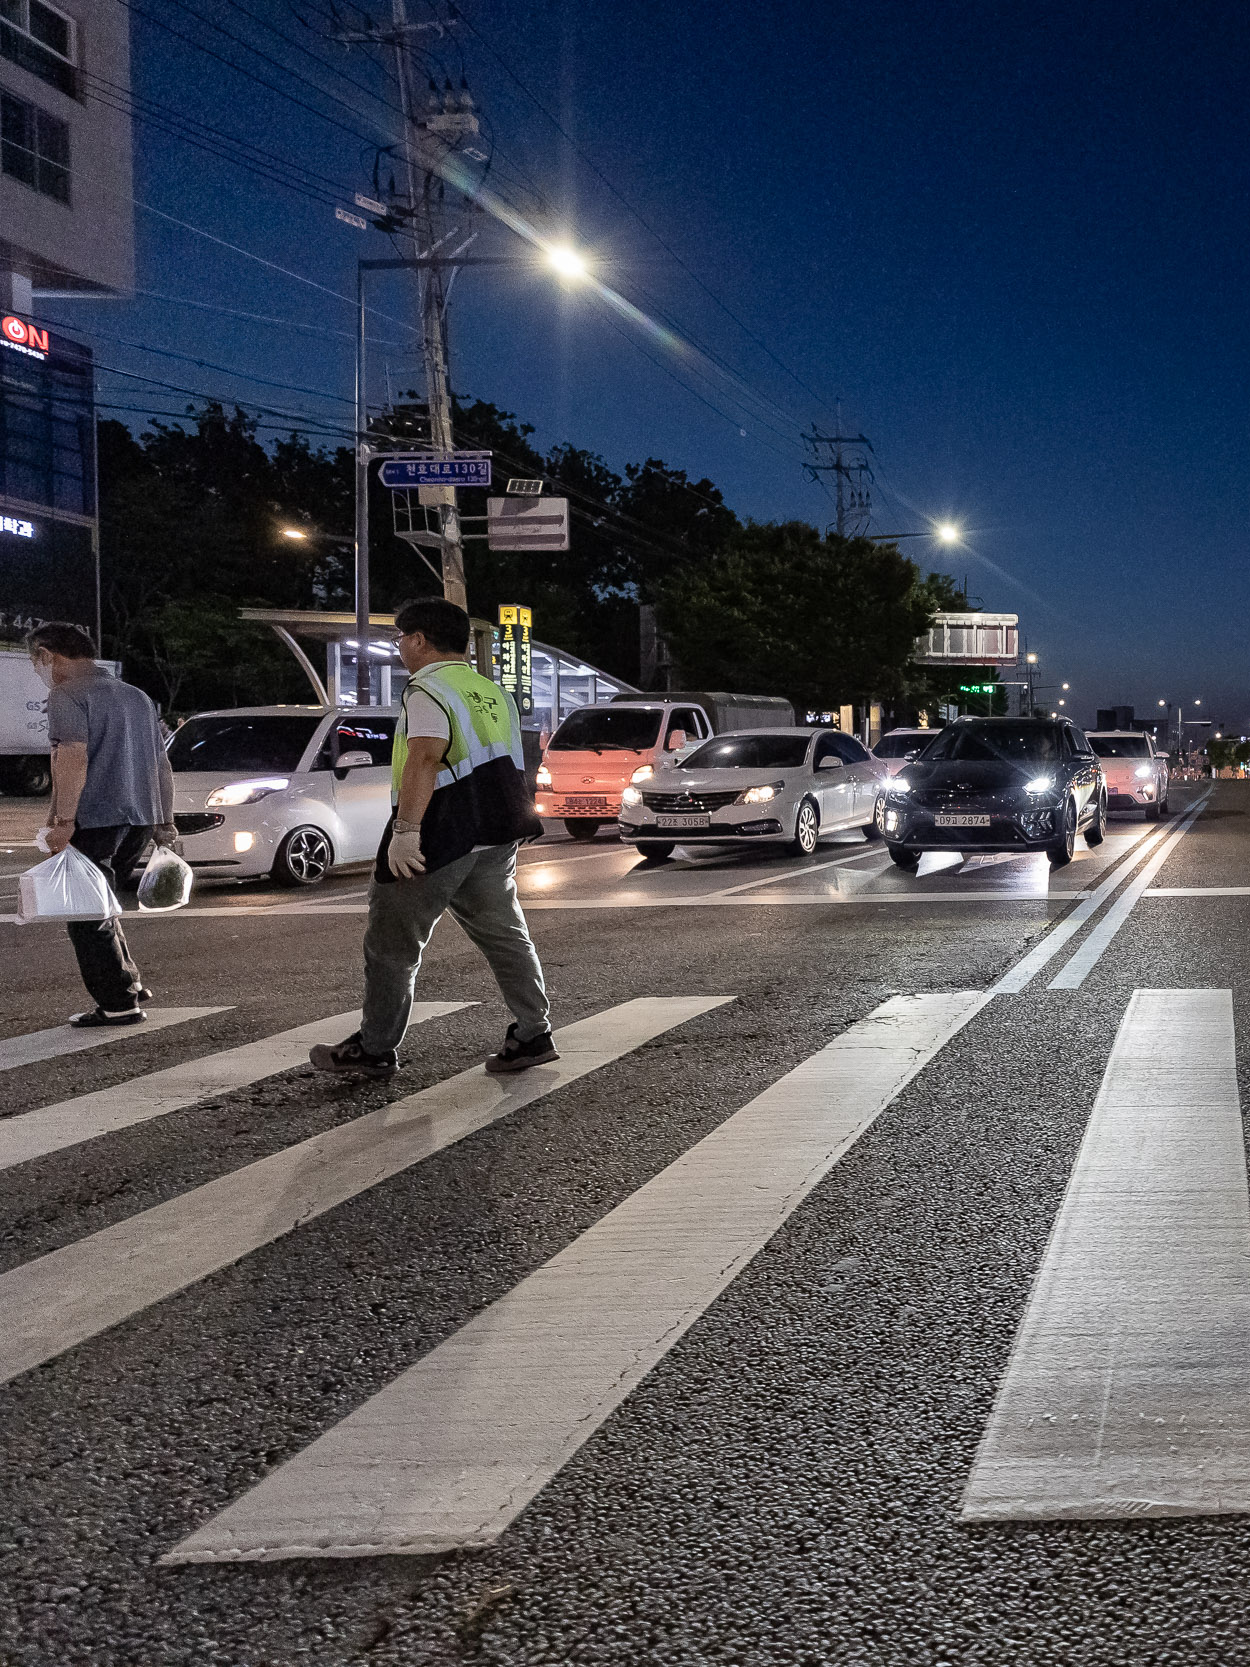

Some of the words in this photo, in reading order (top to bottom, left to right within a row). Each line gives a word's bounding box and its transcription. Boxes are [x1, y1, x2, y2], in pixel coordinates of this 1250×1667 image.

[406, 463, 487, 476] 천호대로130길
[505, 624, 513, 634] 3
[962, 815, 985, 825] 2874
